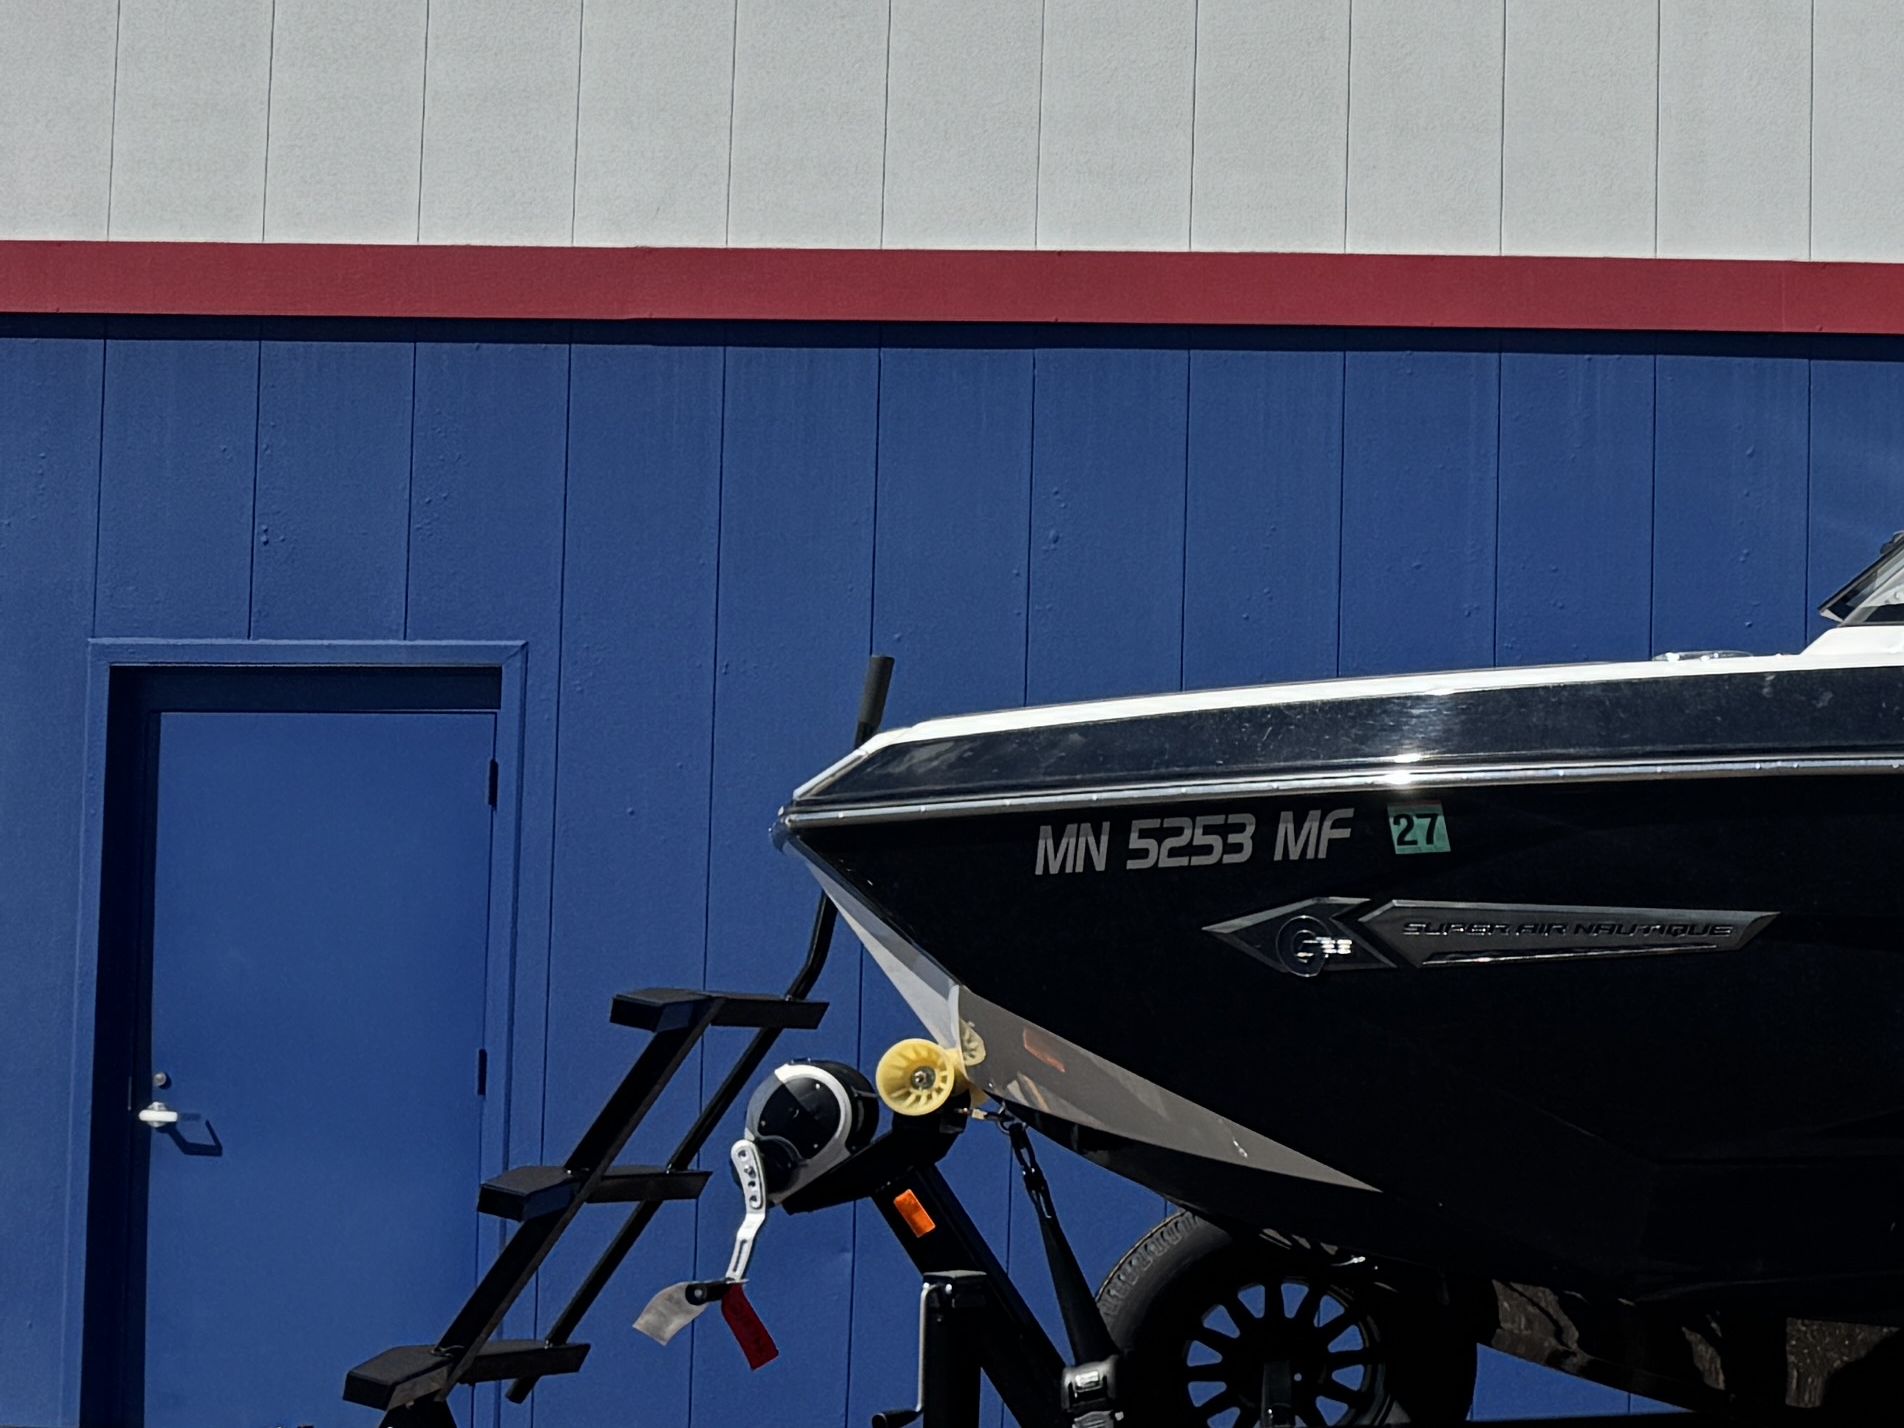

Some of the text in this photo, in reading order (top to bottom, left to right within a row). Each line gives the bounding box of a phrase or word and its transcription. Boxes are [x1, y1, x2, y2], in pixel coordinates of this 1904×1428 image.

[1035, 808, 1355, 875] MN 5253 MF
[1393, 813, 1439, 846] 27
[1402, 922, 1734, 938] SUPER AIR NAUTIQUE
